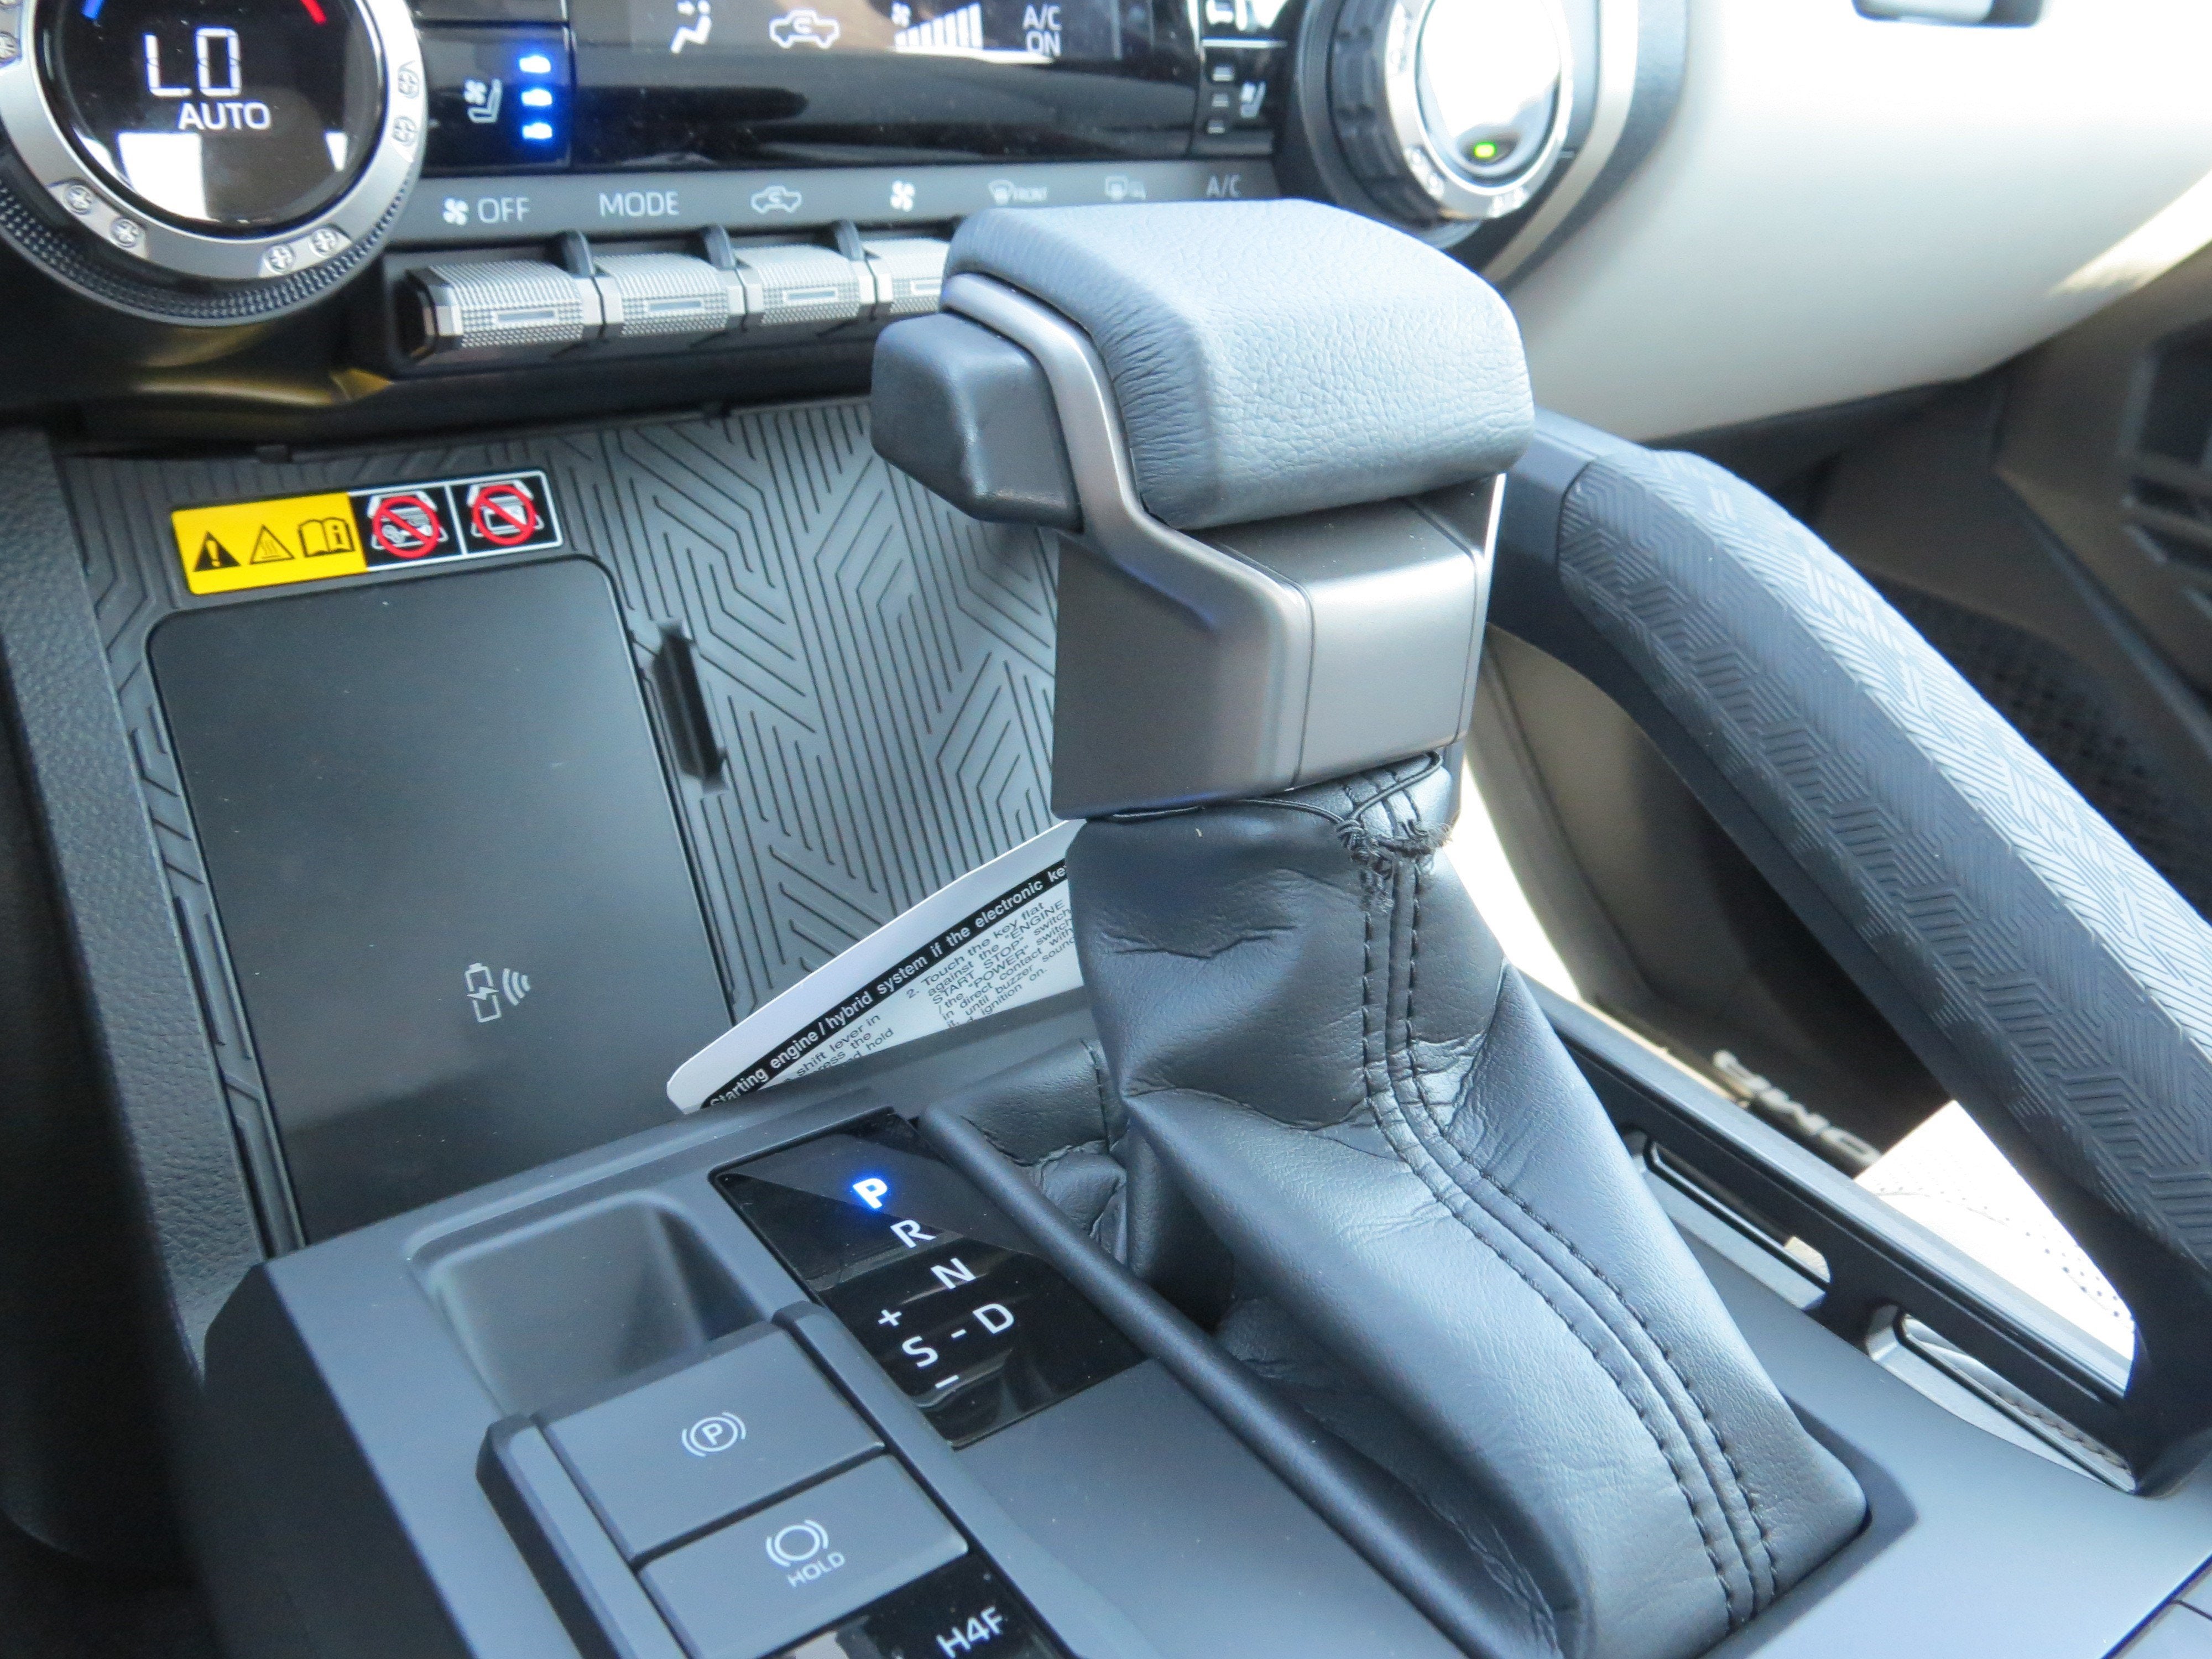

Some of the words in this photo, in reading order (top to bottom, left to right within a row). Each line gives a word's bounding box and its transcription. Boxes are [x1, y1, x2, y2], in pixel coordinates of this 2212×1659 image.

[1022, 3, 1062, 31] A/C
[1026, 30, 1061, 56] ON
[178, 101, 272, 131] AUTO
[1206, 175, 1242, 197] A/C
[477, 196, 530, 223] OFF
[598, 191, 680, 217] MODE
[770, 1031, 819, 1068] engine
[817, 1021, 826, 1035] /
[826, 991, 872, 1029] hybrid
[877, 956, 928, 995] system
[931, 942, 943, 958] if
[946, 927, 971, 947] the
[975, 880, 1044, 928] electronic
[1047, 865, 1067, 882] ke
[906, 988, 920, 999] 2.
[921, 955, 965, 986] Touch
[968, 938, 990, 957] the
[993, 919, 1018, 938] key
[1021, 902, 1044, 920] flat
[932, 970, 974, 1004] START
[1034, 909, 1072, 935] switch
[928, 961, 974, 996] against
[979, 945, 999, 960] the
[942, 1009, 954, 1020] in
[960, 982, 993, 1008] direct
[999, 948, 1042, 980] contact
[1049, 928, 1074, 946] with
[945, 993, 964, 1008] the
[965, 995, 990, 1015] until
[995, 964, 1033, 994] buzzer
[981, 983, 1022, 1015] ignition
[797, 1052, 827, 1076] shift
[830, 1025, 863, 1052] lever
[865, 1015, 880, 1027] in
[851, 1033, 872, 1049] the
[866, 1027, 894, 1050] hold
[852, 1177, 889, 1209] P
[890, 1219, 937, 1248] R
[930, 1257, 977, 1290] N
[901, 1335, 939, 1368] S
[972, 1303, 1015, 1334] D
[786, 1551, 846, 1588] HOLD
[935, 1606, 1005, 1658] H4F
